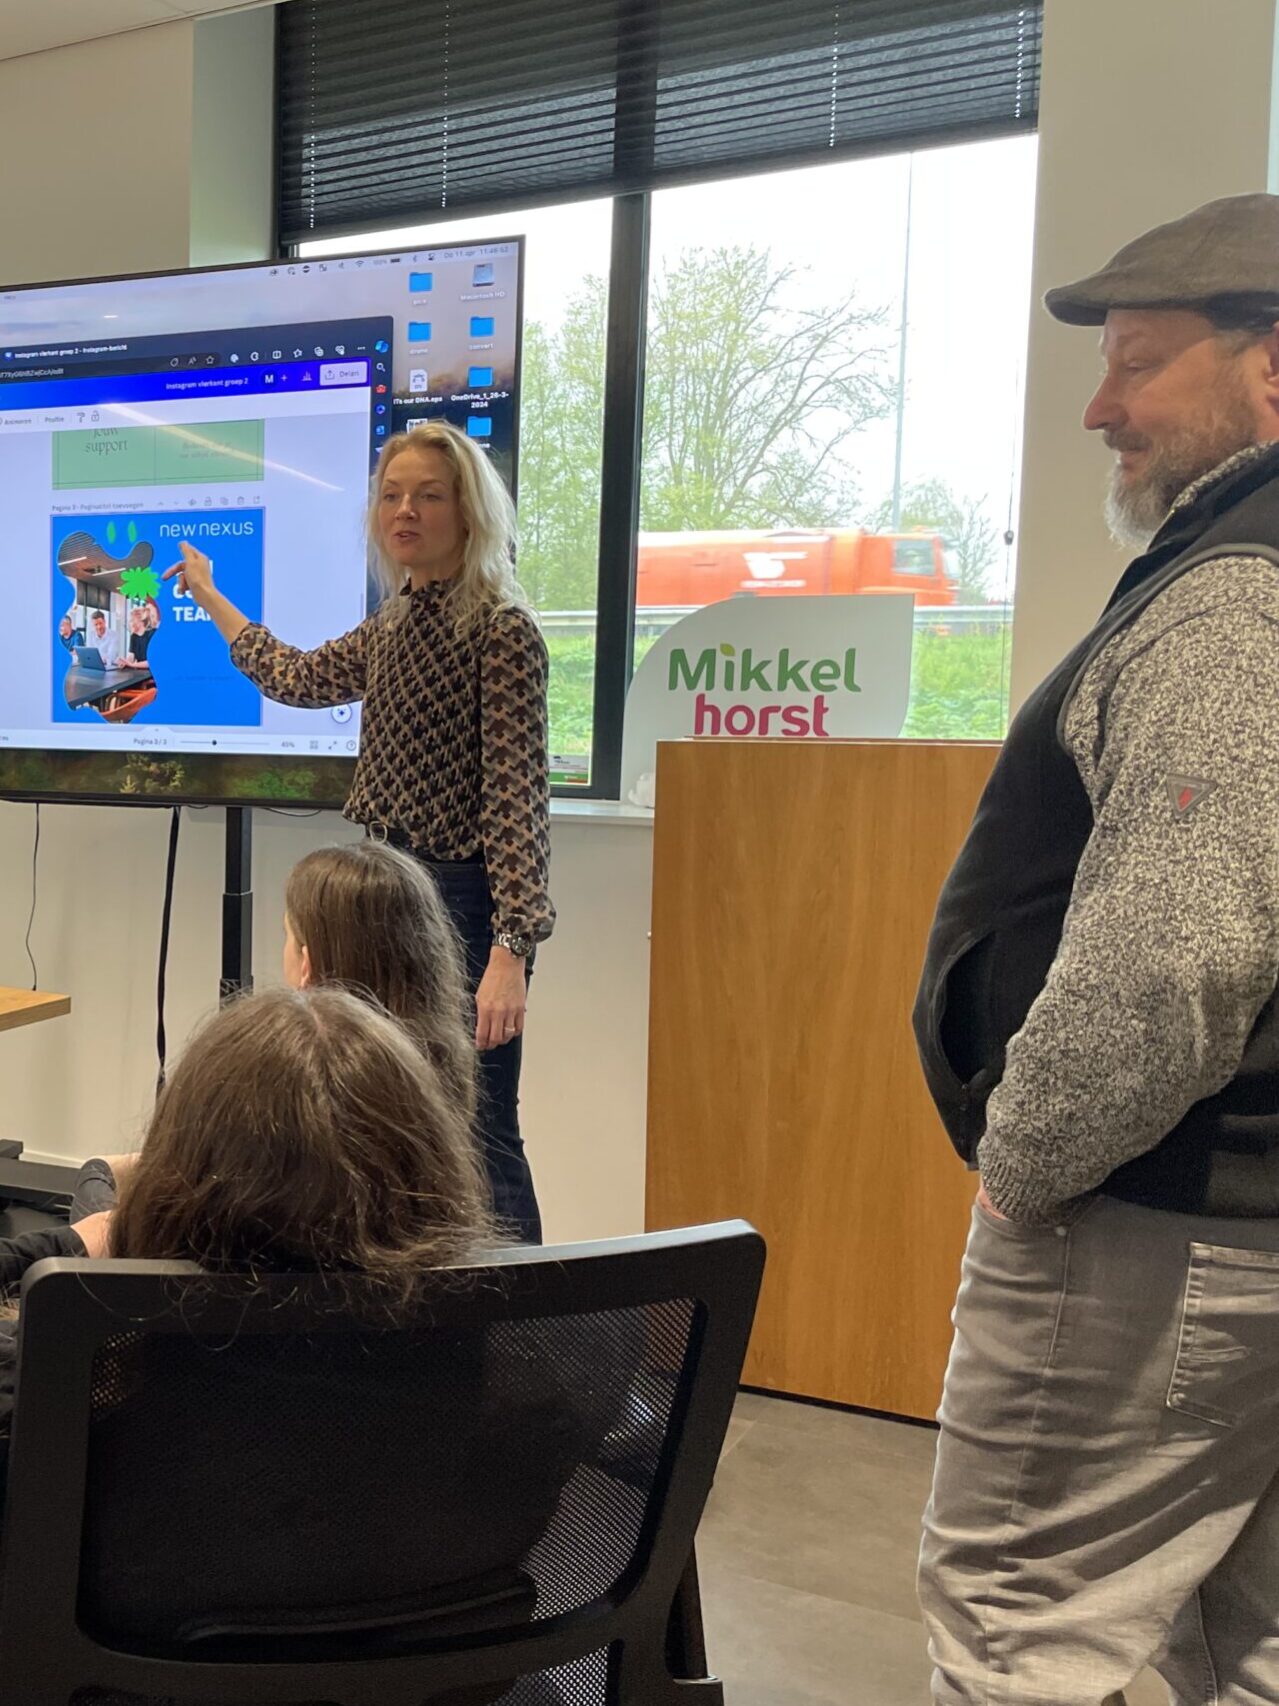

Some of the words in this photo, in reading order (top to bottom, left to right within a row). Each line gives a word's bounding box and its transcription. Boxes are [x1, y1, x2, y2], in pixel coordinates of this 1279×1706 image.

[166, 382, 197, 391] Instagram
[198, 379, 224, 389] vierkant
[224, 378, 243, 388] groep
[264, 374, 274, 384] M
[85, 439, 127, 455] support
[668, 643, 862, 693] Mikkel
[694, 693, 829, 737] horst
